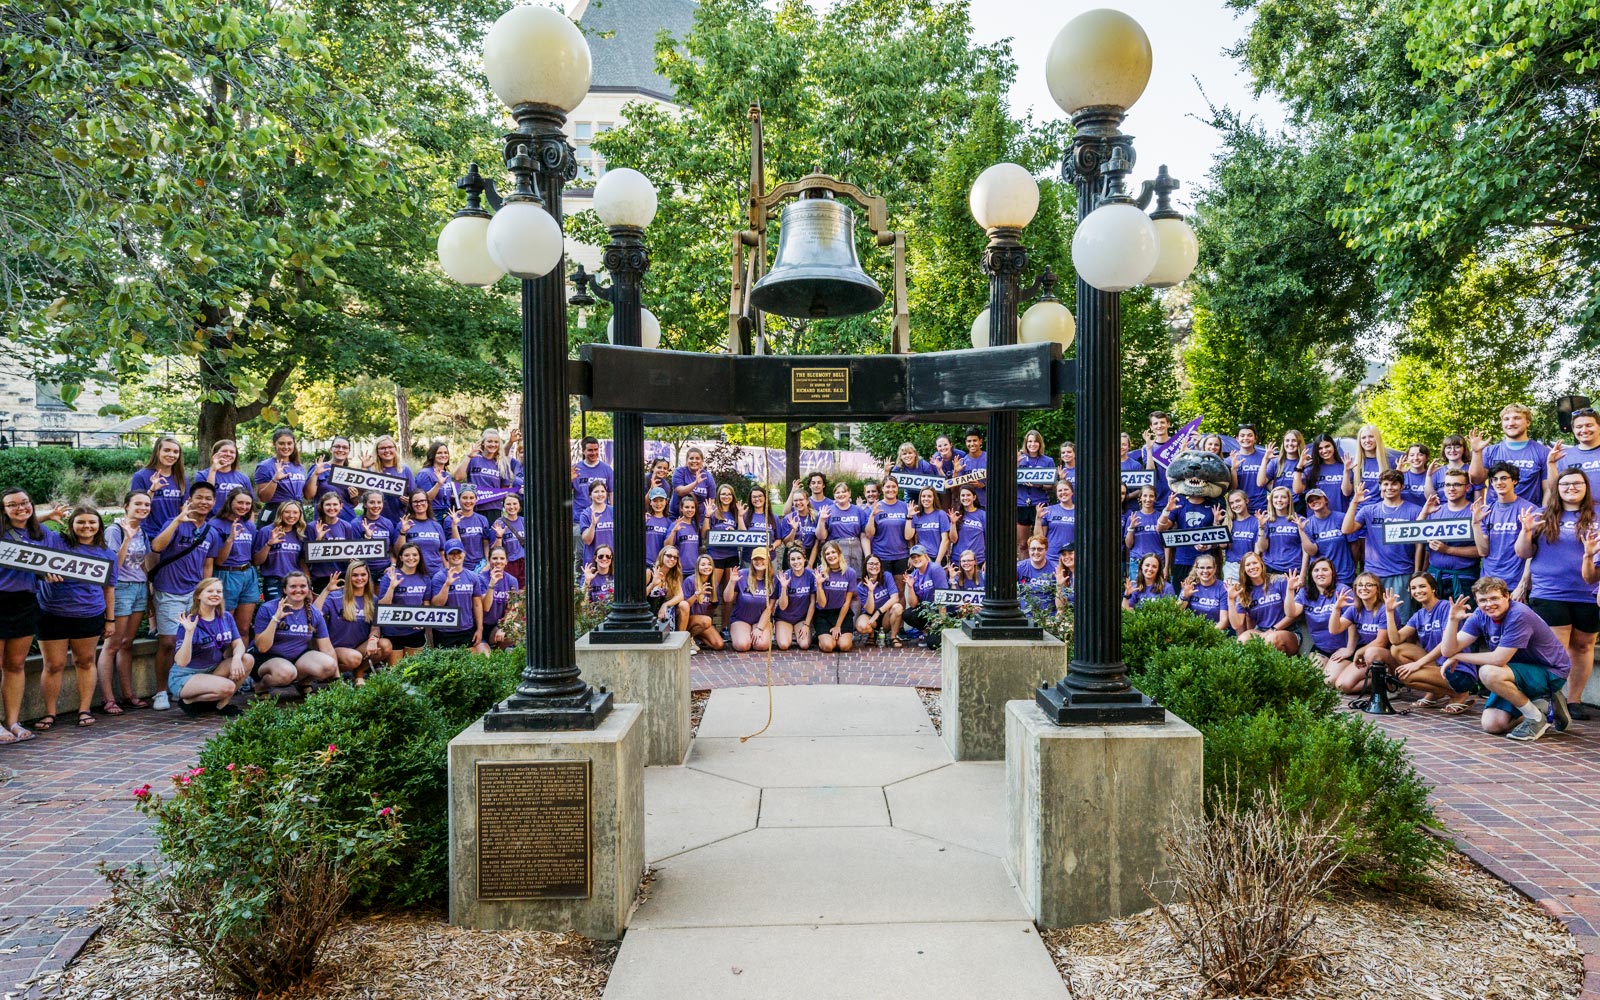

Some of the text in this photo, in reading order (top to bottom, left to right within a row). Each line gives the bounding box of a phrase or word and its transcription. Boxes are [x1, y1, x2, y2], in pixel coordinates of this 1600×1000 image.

[335, 471, 404, 493] #EDCATS
[955, 470, 986, 485] FAMILY
[1017, 471, 1053, 480] DCATS
[1121, 474, 1152, 484] CATS
[899, 476, 944, 489] EDCATS
[963, 520, 983, 528] CATS
[1166, 530, 1227, 544] #EDCATS
[1233, 530, 1254, 539] CATS
[1387, 524, 1467, 539] #EDCATS
[311, 543, 383, 558] #EDCATS
[0, 547, 106, 578] #EDCATS
[380, 611, 456, 623] #EDCATS
